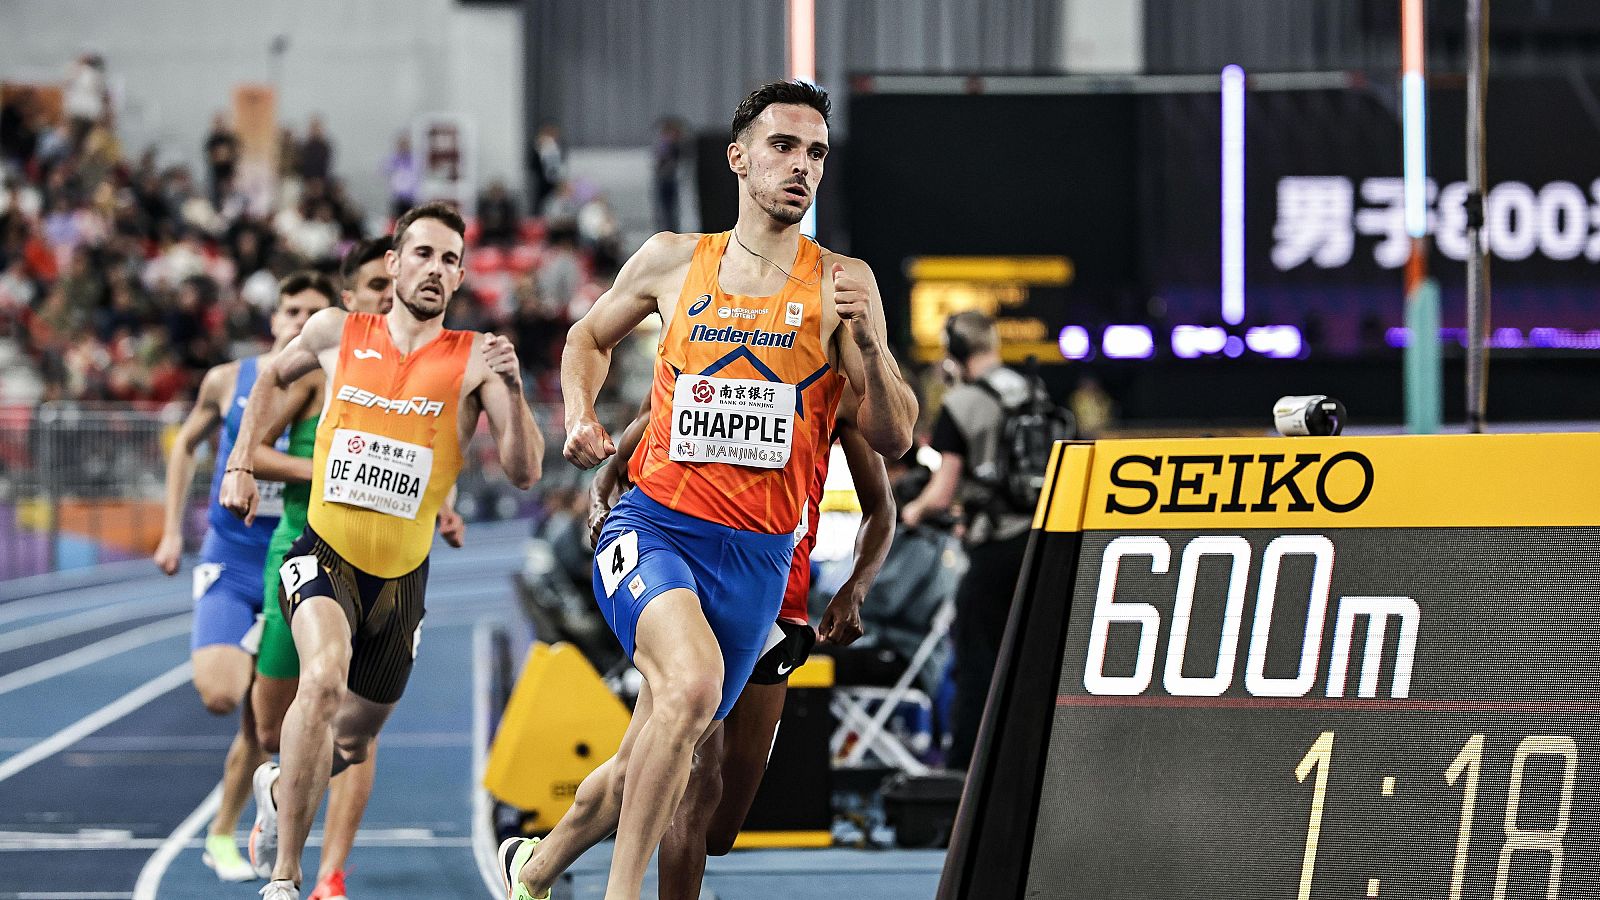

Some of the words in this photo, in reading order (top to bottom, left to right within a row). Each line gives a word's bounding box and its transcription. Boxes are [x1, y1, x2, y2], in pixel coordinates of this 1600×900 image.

[1271, 175, 1600, 271] 男子800
[336, 384, 446, 417] ESPAÑA
[719, 384, 776, 403] 南京银行
[748, 401, 775, 409] NANJING
[678, 409, 787, 444] CHAPPLE
[330, 459, 352, 481] DE
[354, 463, 421, 498] ARRIBA
[1104, 450, 1375, 515] SEIKO
[289, 563, 301, 587] 3
[611, 543, 625, 576] 4
[1083, 534, 1421, 699] 600m
